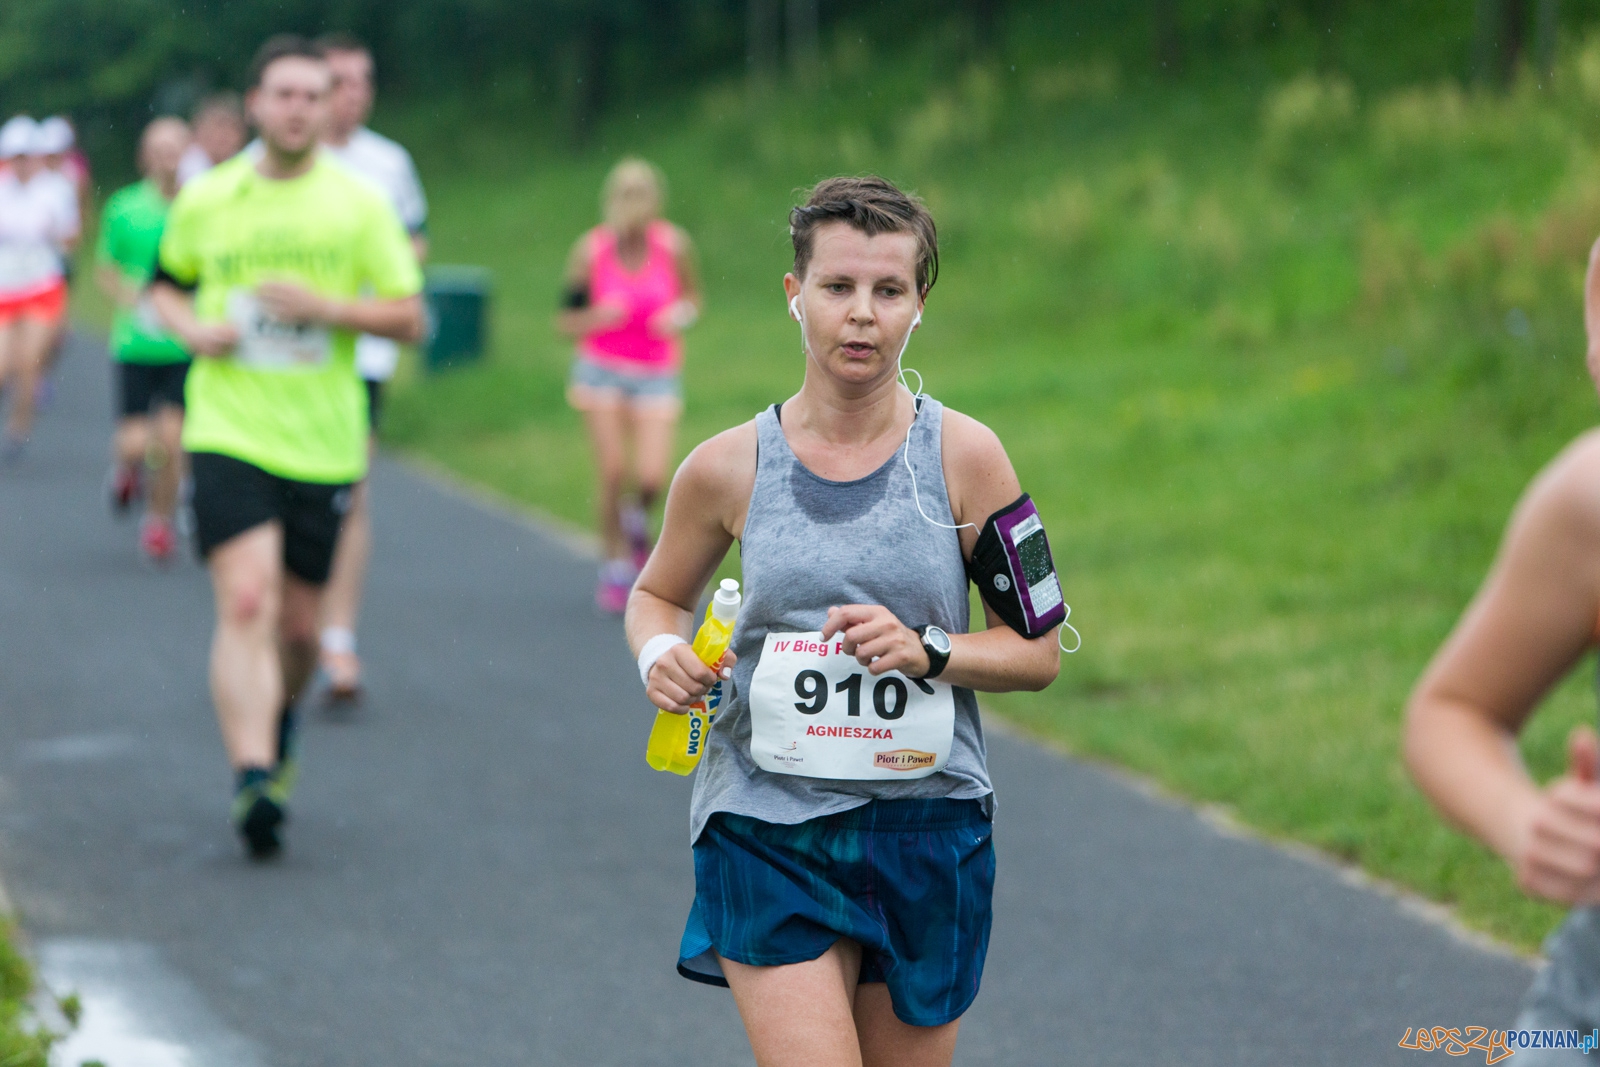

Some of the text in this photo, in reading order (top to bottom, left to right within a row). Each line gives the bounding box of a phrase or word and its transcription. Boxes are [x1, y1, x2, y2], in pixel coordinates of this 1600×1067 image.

[773, 640, 791, 653] IV
[792, 639, 829, 657] Bieg
[793, 669, 908, 721] 910
[806, 725, 894, 740] AGNIESZKA
[876, 754, 933, 764] Piotr i Paweł
